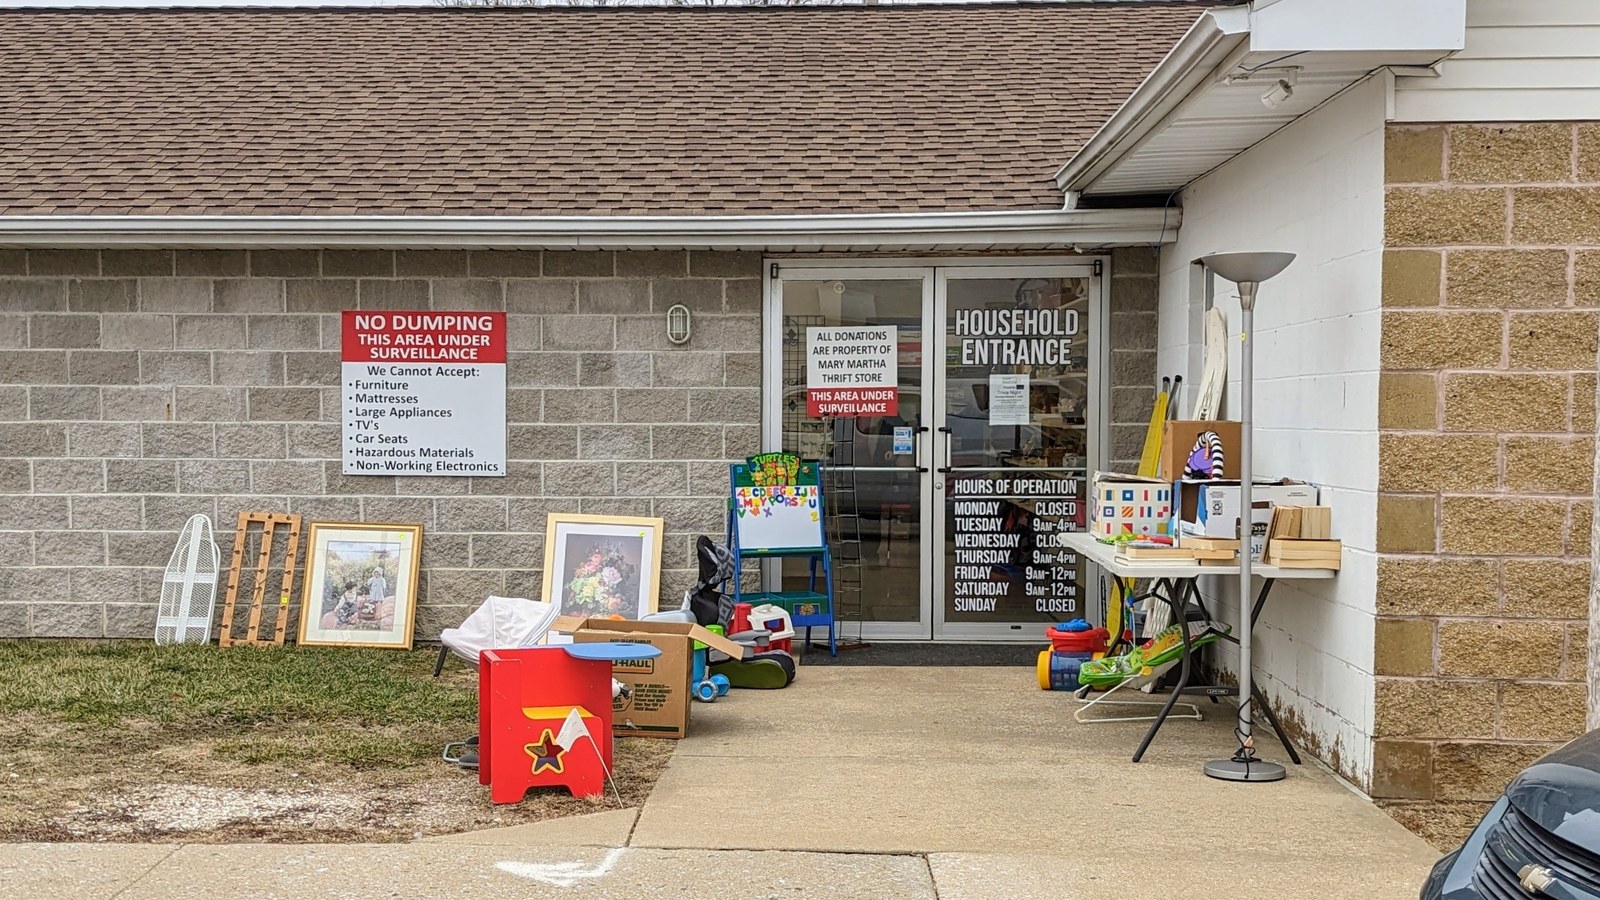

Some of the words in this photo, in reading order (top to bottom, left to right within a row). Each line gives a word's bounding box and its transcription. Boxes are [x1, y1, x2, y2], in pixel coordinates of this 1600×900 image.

[355, 315, 386, 330] NO
[392, 315, 493, 331] DUMPING
[955, 309, 1079, 336] HOUSEHOLD
[358, 334, 391, 346] THIS
[394, 334, 434, 346] AREA
[438, 334, 490, 346] UNDER
[816, 332, 832, 341] ALL
[834, 331, 887, 341] DONATIONS
[370, 347, 478, 360] SURVEILLANCE
[812, 346, 829, 355] ARE
[832, 345, 878, 355] PROPERTY
[879, 345, 891, 354] OF
[962, 339, 1072, 365] ENTRANCE
[818, 360, 845, 369] MARY
[846, 359, 886, 368] MARTHA
[367, 366, 386, 376] We
[390, 366, 432, 376] Cannot
[435, 366, 480, 379] Accept:
[822, 374, 853, 383] THRIFT
[854, 373, 883, 382] STORE
[355, 380, 409, 390] Furniture
[355, 394, 418, 404] Mattresses
[811, 391, 832, 401] THIS
[833, 391, 859, 401] AREA
[861, 390, 894, 400] UNDER
[355, 407, 386, 419] Large
[389, 407, 452, 419] Appliances
[818, 403, 887, 413] SURVEILLANCE
[355, 420, 379, 430] TV's
[355, 434, 374, 444] Car
[378, 434, 408, 444] Seats
[355, 447, 416, 457] Hazardous
[419, 448, 474, 458] Materials
[752, 453, 796, 468] TURTLES
[356, 461, 433, 473] Non-Working
[436, 461, 498, 472] Electronics
[955, 479, 993, 494] HOURS
[995, 479, 1010, 494] OF
[1014, 479, 1077, 494] OPERATION
[955, 502, 1000, 515] MONDAY
[1035, 502, 1076, 516] CLOSED
[955, 518, 1003, 531] TUESDAY
[955, 534, 1020, 547] WEDNESDAY
[1036, 534, 1064, 547] CLOS
[955, 550, 1011, 563] THURSDAY
[955, 566, 992, 579] FRIDAY
[955, 582, 1009, 595] SATURDAY
[955, 598, 997, 611] SUNDAY
[1036, 599, 1076, 612] CLOSED
